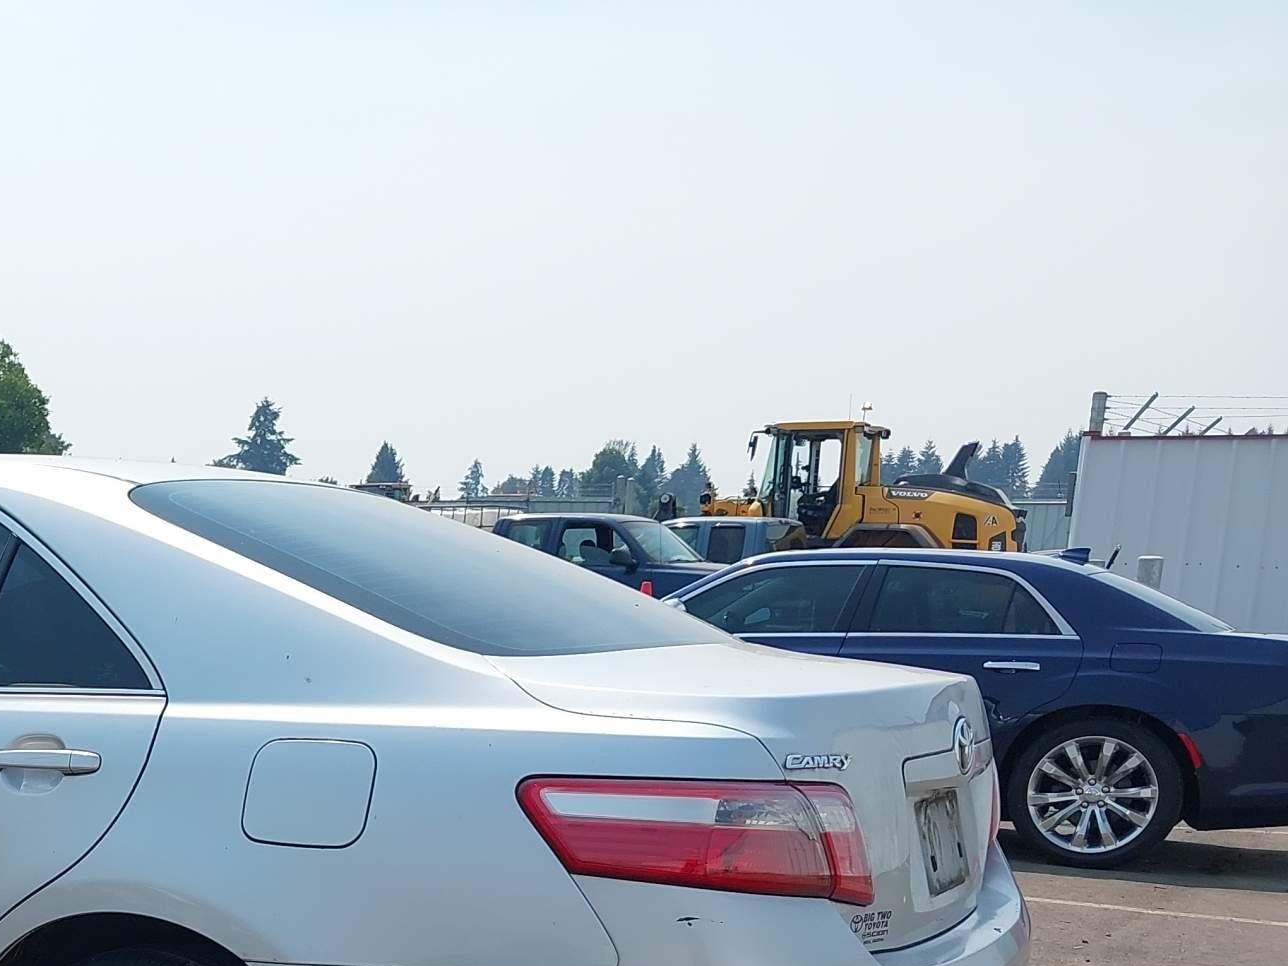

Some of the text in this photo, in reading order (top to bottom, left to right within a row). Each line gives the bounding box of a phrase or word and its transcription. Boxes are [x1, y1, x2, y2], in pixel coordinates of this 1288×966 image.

[890, 489, 928, 498] VOLVO
[863, 910, 892, 923] BIG TWO
[864, 919, 889, 931] TOYOTA
